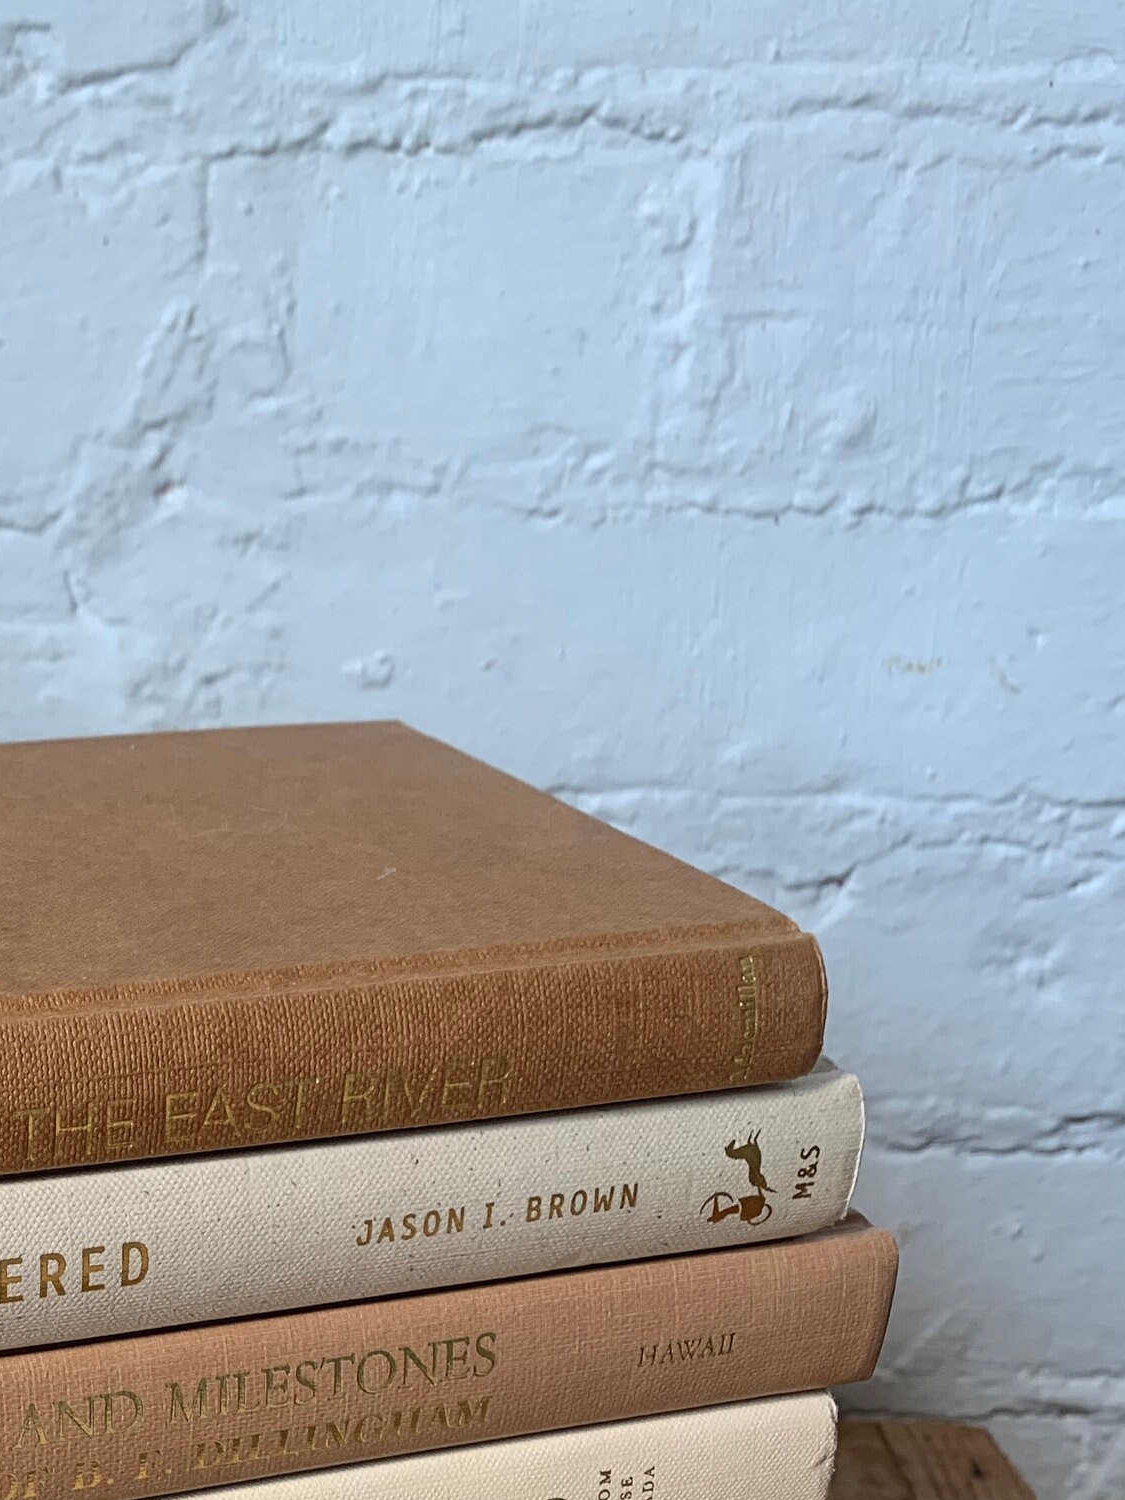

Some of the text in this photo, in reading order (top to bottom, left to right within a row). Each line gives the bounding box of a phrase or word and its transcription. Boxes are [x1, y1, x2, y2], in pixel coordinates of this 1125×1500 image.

[15, 1098, 134, 1162] THE
[165, 1077, 318, 1145] EAST
[341, 1057, 512, 1124] RIVER
[792, 1144, 821, 1200] M&S
[355, 1183, 640, 1247] JASON I. BROWN
[638, 1332, 737, 1369] HAWAII
[14, 1390, 141, 1448] AND
[164, 1332, 498, 1423] MILESTONES
